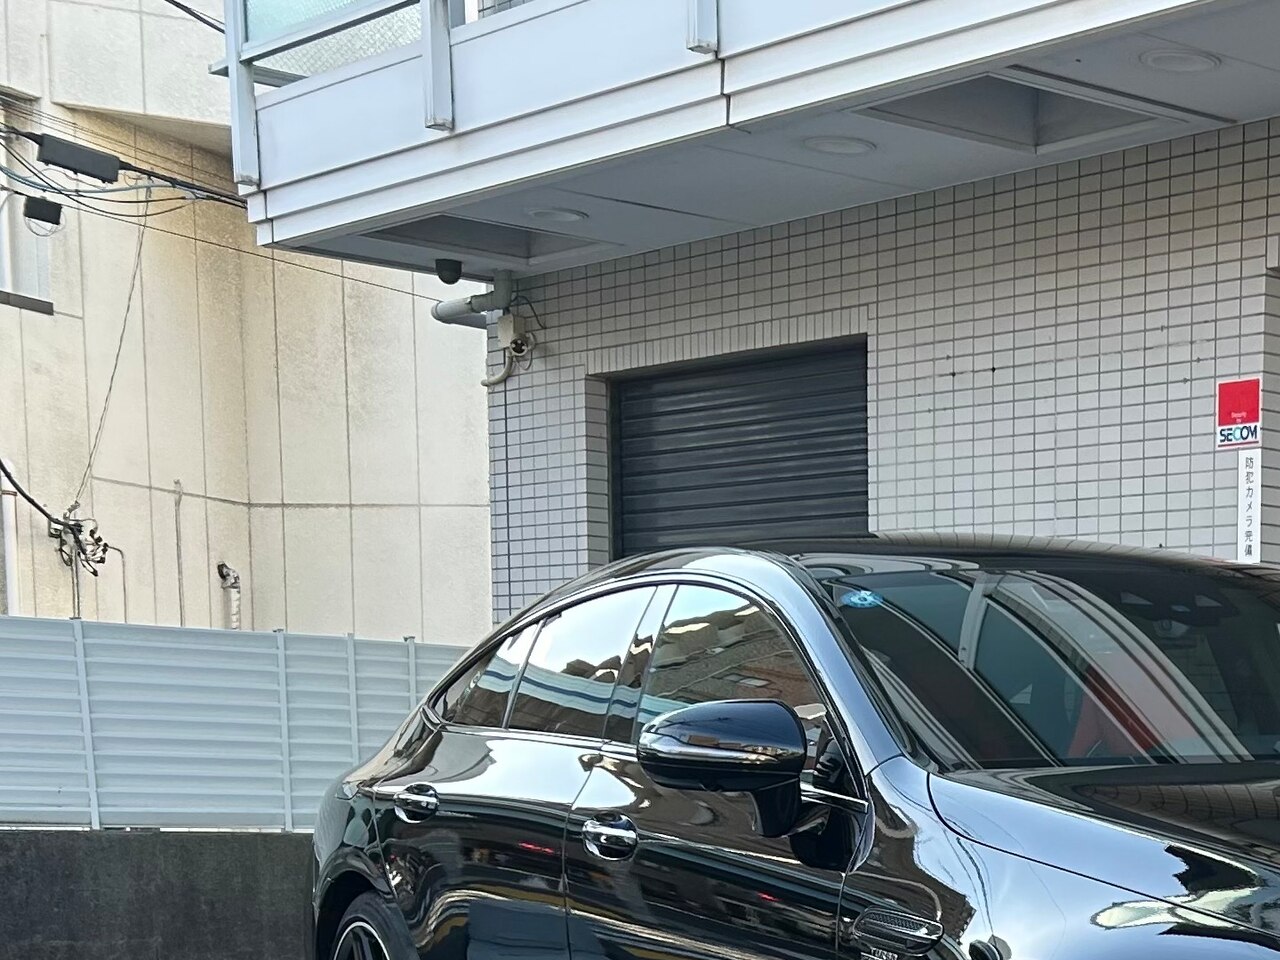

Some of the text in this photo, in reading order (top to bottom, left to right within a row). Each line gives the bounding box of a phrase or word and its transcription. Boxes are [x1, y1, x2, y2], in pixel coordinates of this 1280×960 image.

[1220, 425, 1257, 443] SECOM
[1245, 457, 1254, 556] 防犯カメラ完備
